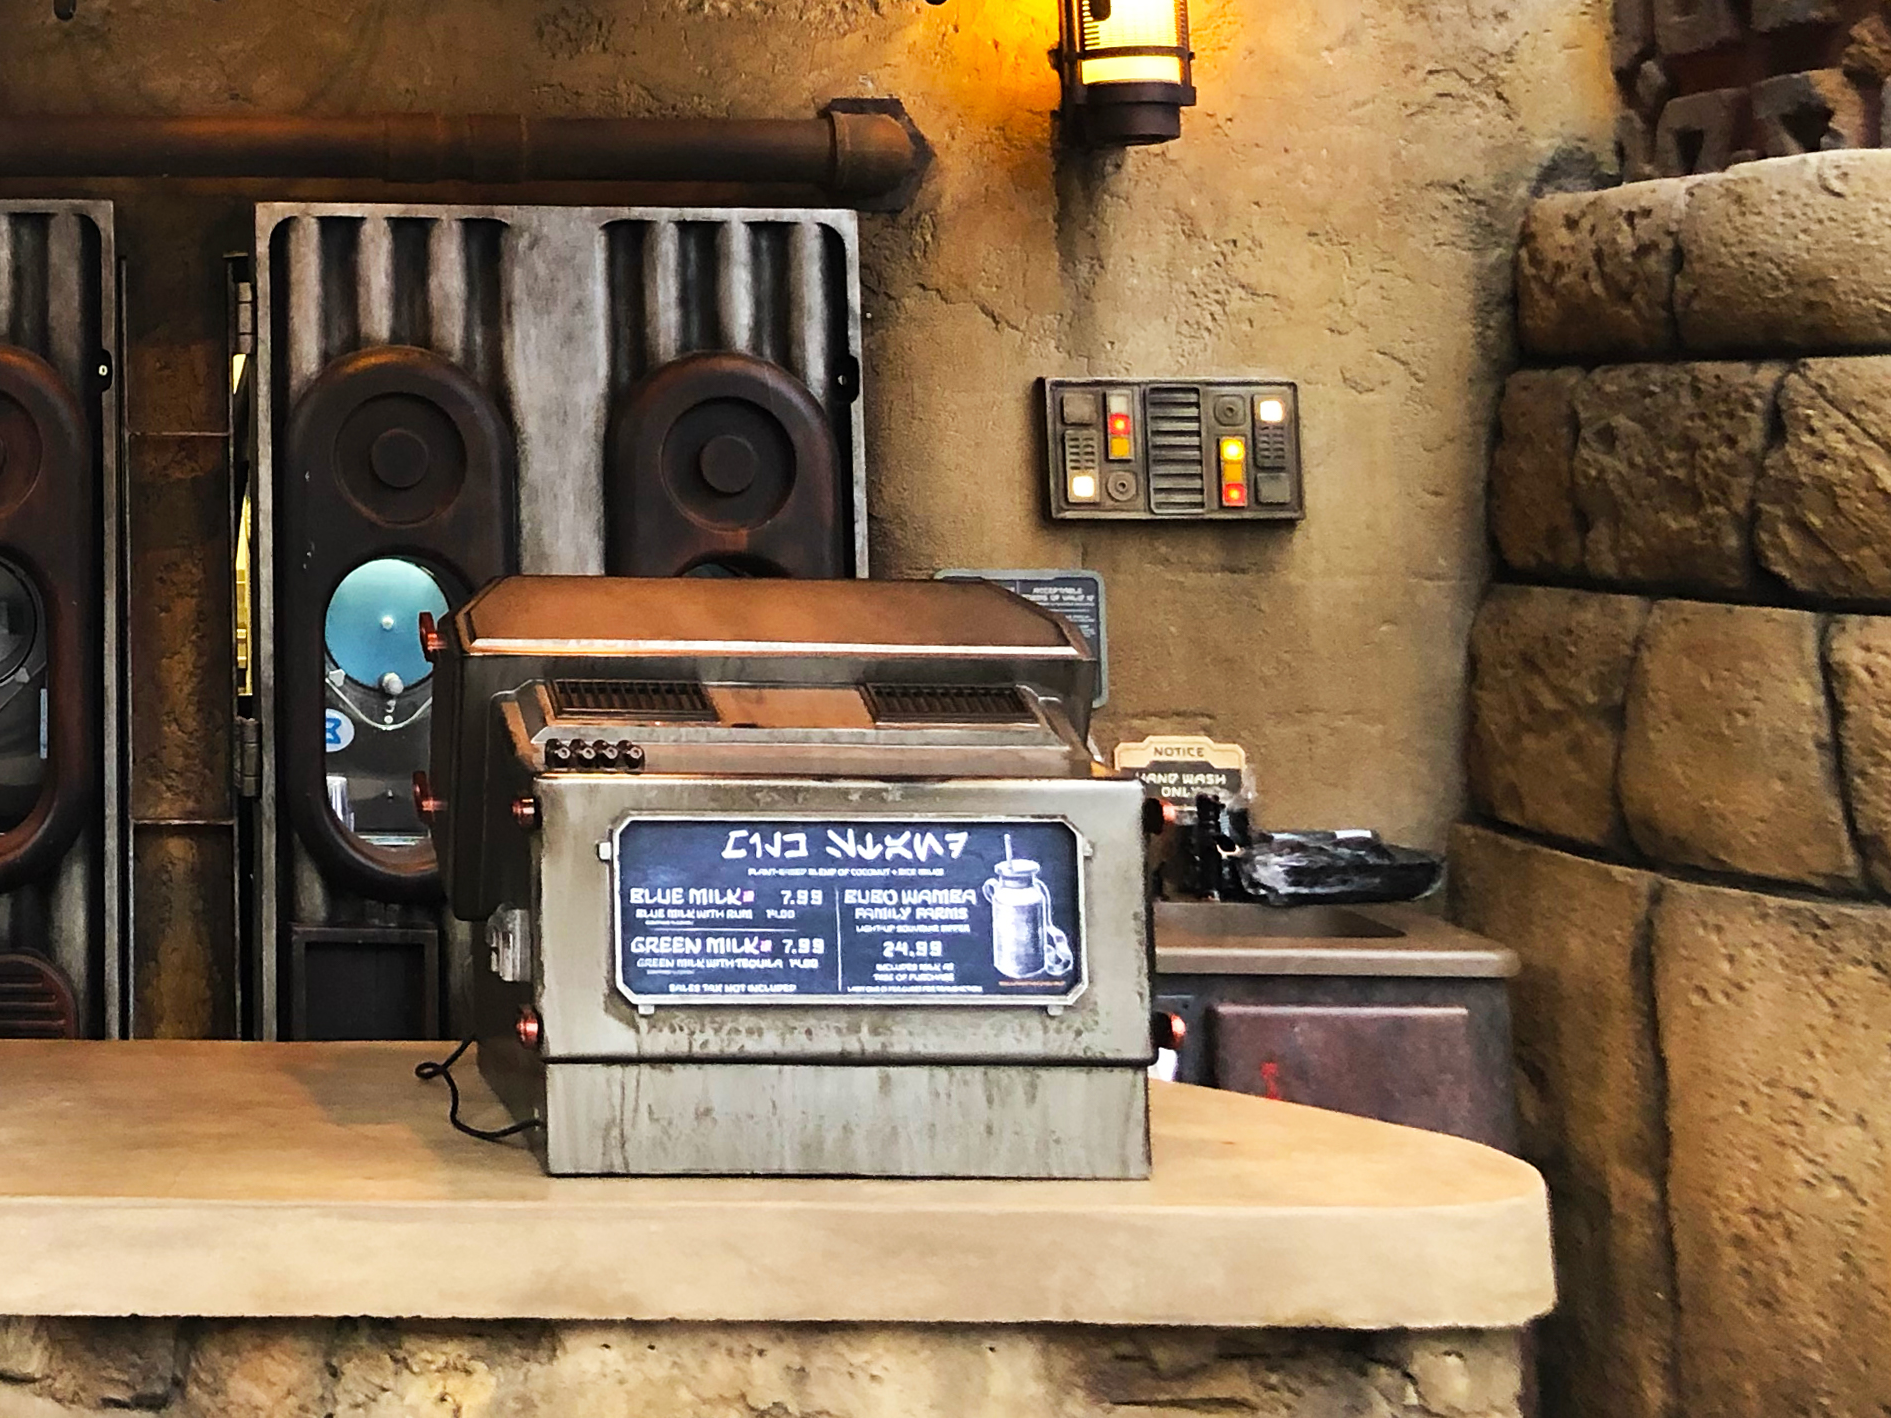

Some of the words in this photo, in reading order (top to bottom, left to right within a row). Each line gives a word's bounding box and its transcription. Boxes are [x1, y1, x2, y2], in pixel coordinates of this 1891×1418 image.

[1154, 747, 1204, 757] NOTICE
[1182, 773, 1226, 785] WASH
[630, 888, 683, 904] BLUE
[689, 887, 742, 906] MILK
[844, 889, 897, 905] BUBO
[902, 889, 976, 905] WAMBA
[636, 909, 665, 919] BLUE
[855, 908, 911, 920] FAMILY
[916, 908, 968, 920] FARMS
[630, 937, 702, 953] GREEN
[706, 936, 760, 954] MILK
[637, 958, 674, 968] GREEN
